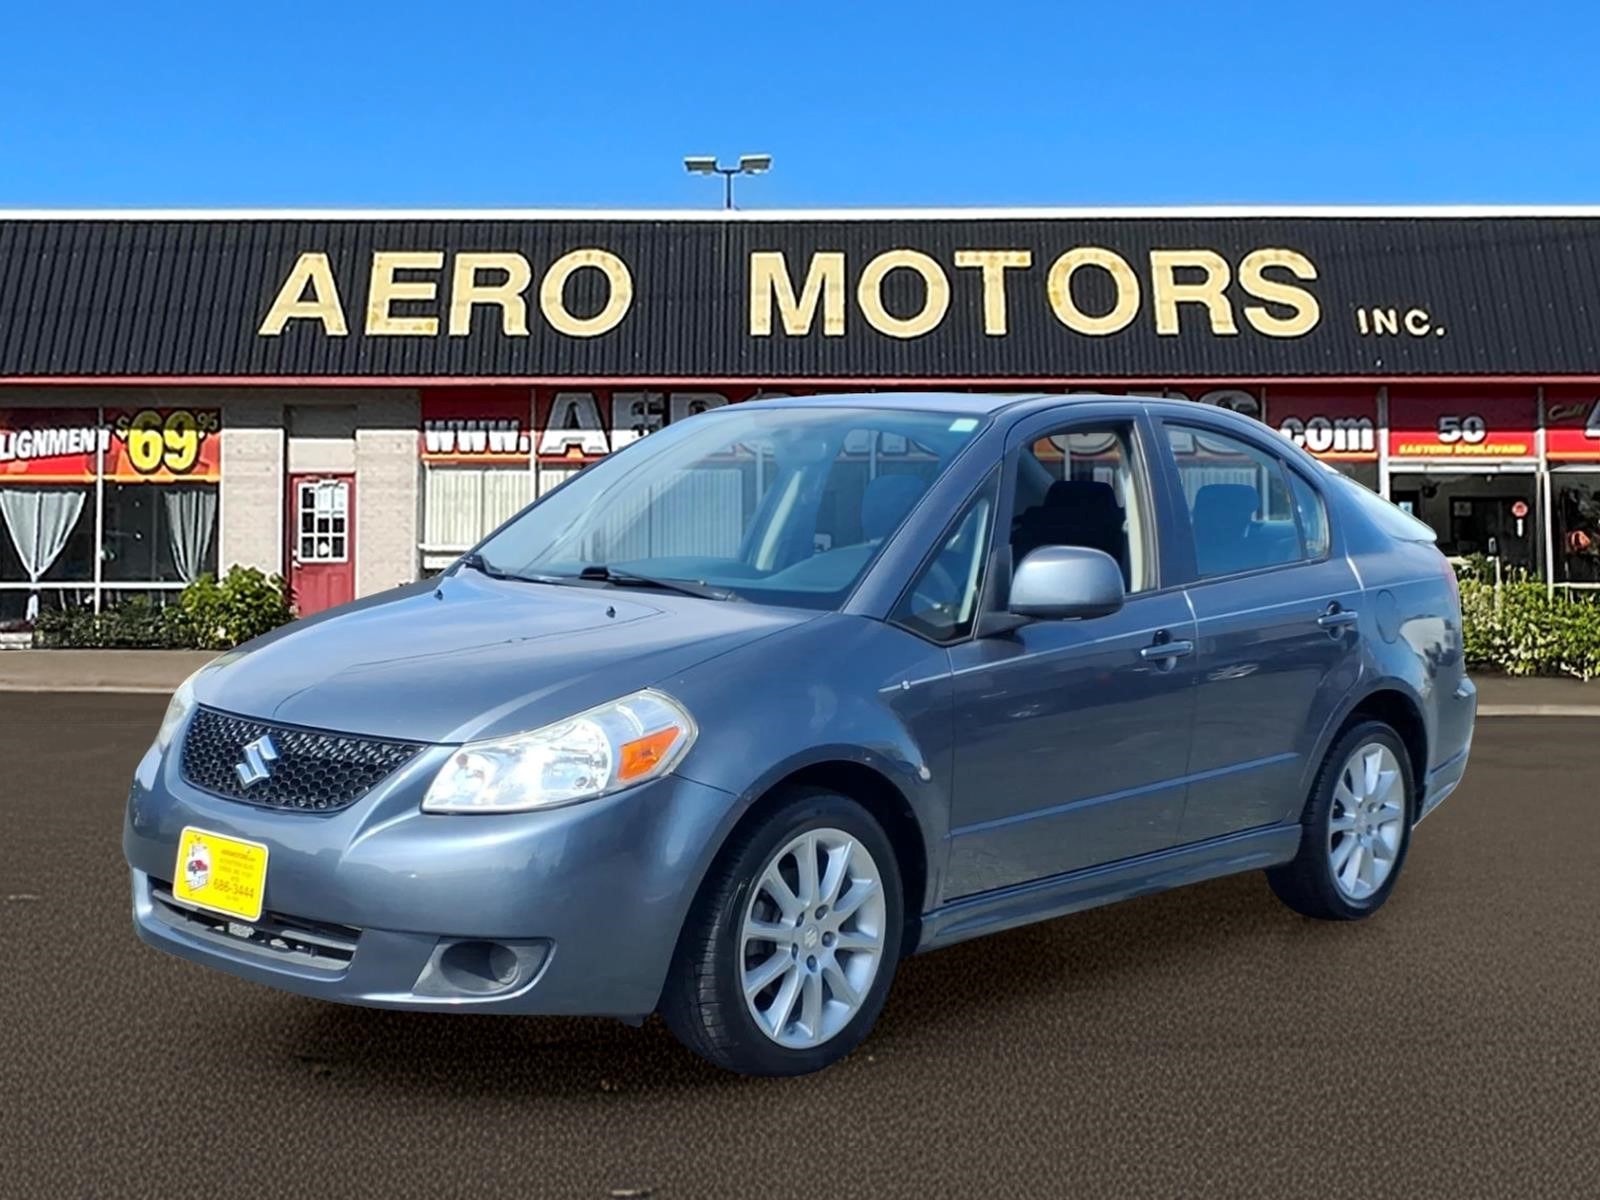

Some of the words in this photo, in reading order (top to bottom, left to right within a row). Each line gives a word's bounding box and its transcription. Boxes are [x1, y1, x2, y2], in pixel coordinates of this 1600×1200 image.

[258, 248, 634, 338] AERO
[749, 246, 1321, 338] MOTORS
[1356, 307, 1446, 336] INC.
[1437, 415, 1486, 443] 50
